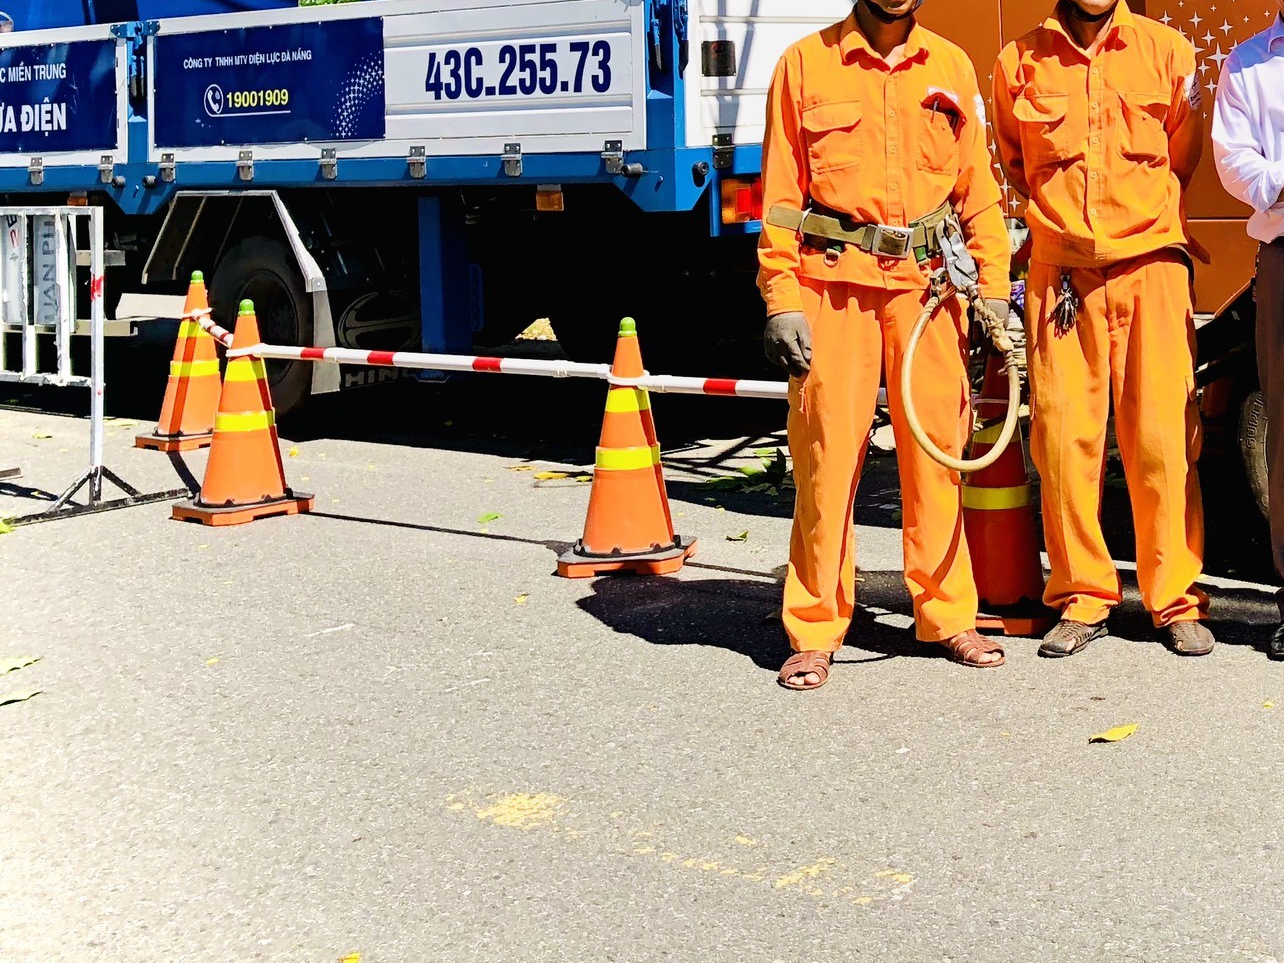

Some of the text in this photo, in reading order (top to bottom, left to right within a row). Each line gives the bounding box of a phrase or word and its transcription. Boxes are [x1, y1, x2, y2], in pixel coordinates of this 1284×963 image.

[183, 57, 203, 69] CÔNG
[204, 57, 213, 68] TY
[215, 56, 233, 67] TNHH
[235, 55, 248, 65] MTV
[249, 51, 265, 66] ĐIỆN
[266, 51, 281, 65] LỰC
[281, 49, 291, 62] ĐÀ
[33, 62, 67, 81] TRUNG
[226, 89, 289, 108] 19001909
[20, 97, 67, 136] ĐIỆN
